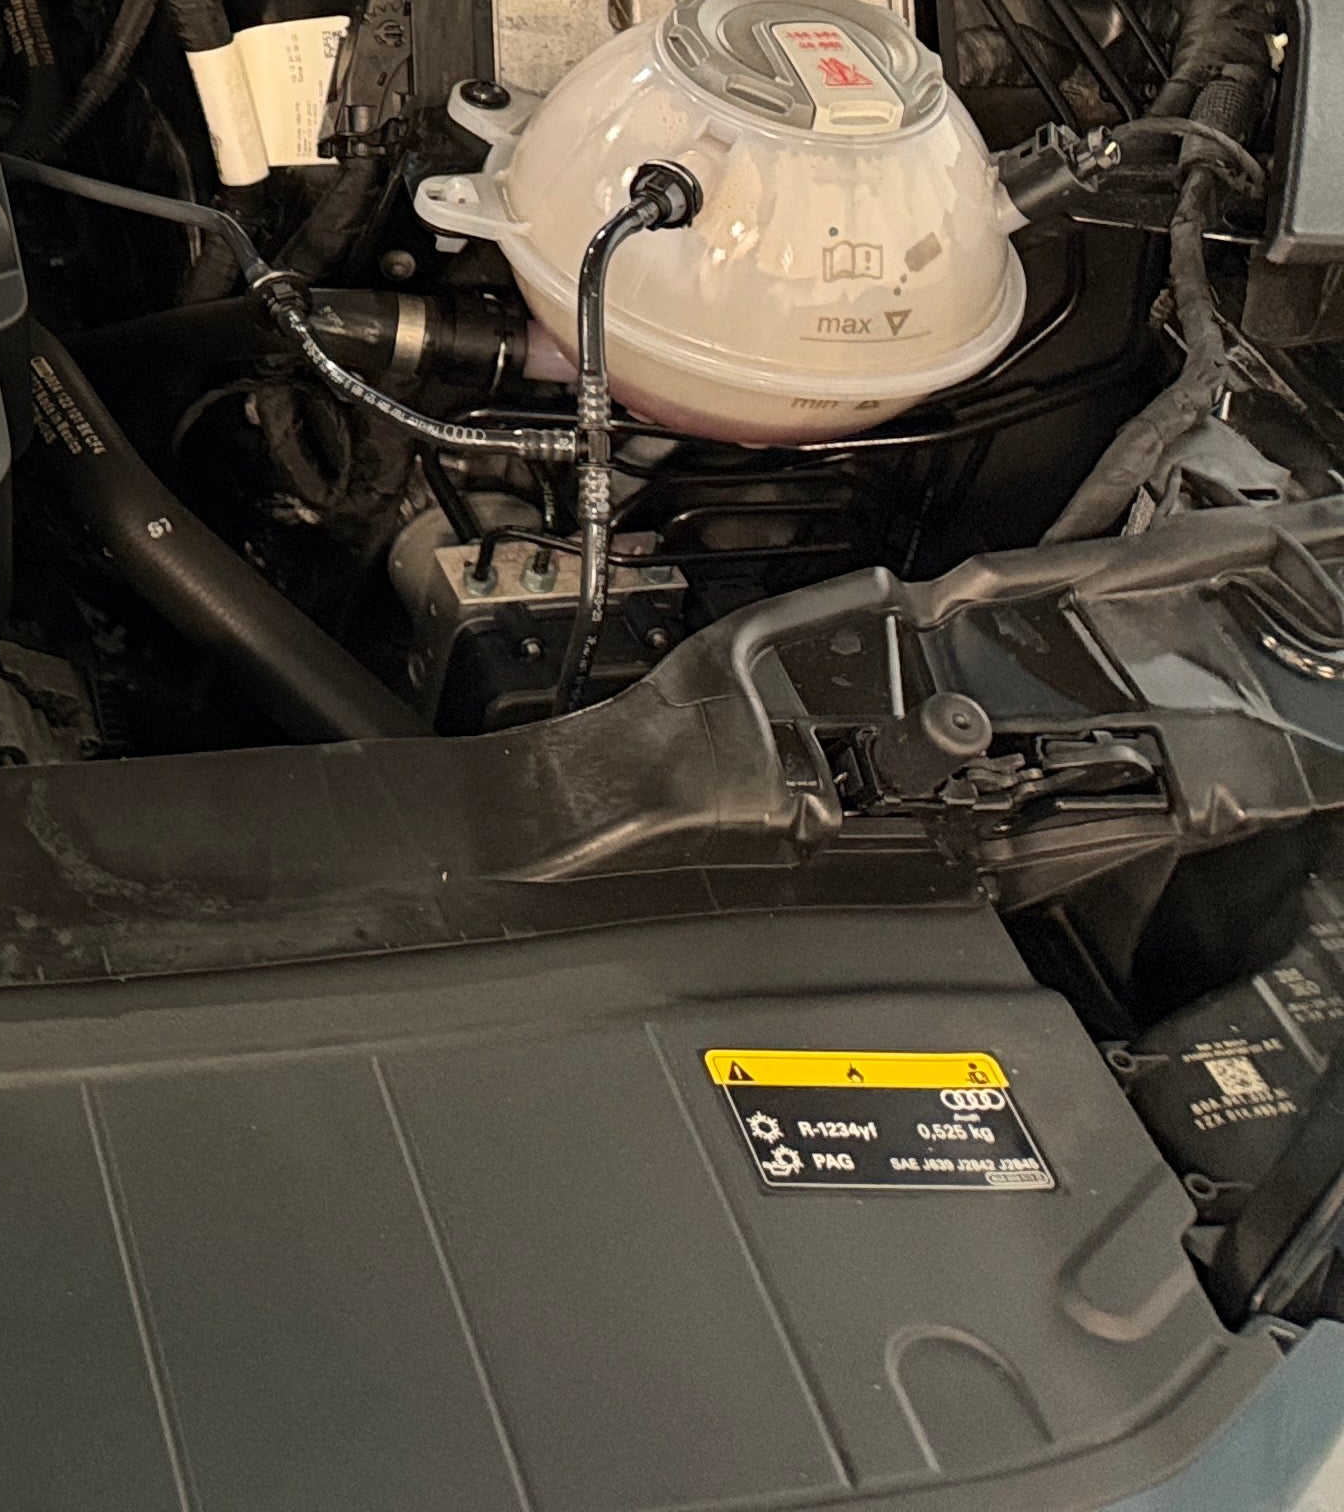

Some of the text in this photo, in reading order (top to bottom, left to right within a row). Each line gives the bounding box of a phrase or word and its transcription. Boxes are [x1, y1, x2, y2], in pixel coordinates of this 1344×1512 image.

[817, 316, 872, 334] max
[797, 1121, 995, 1143] R-1234yf 0,525 kg
[812, 1152, 855, 1170] PAG
[890, 1157, 920, 1170] SAE
